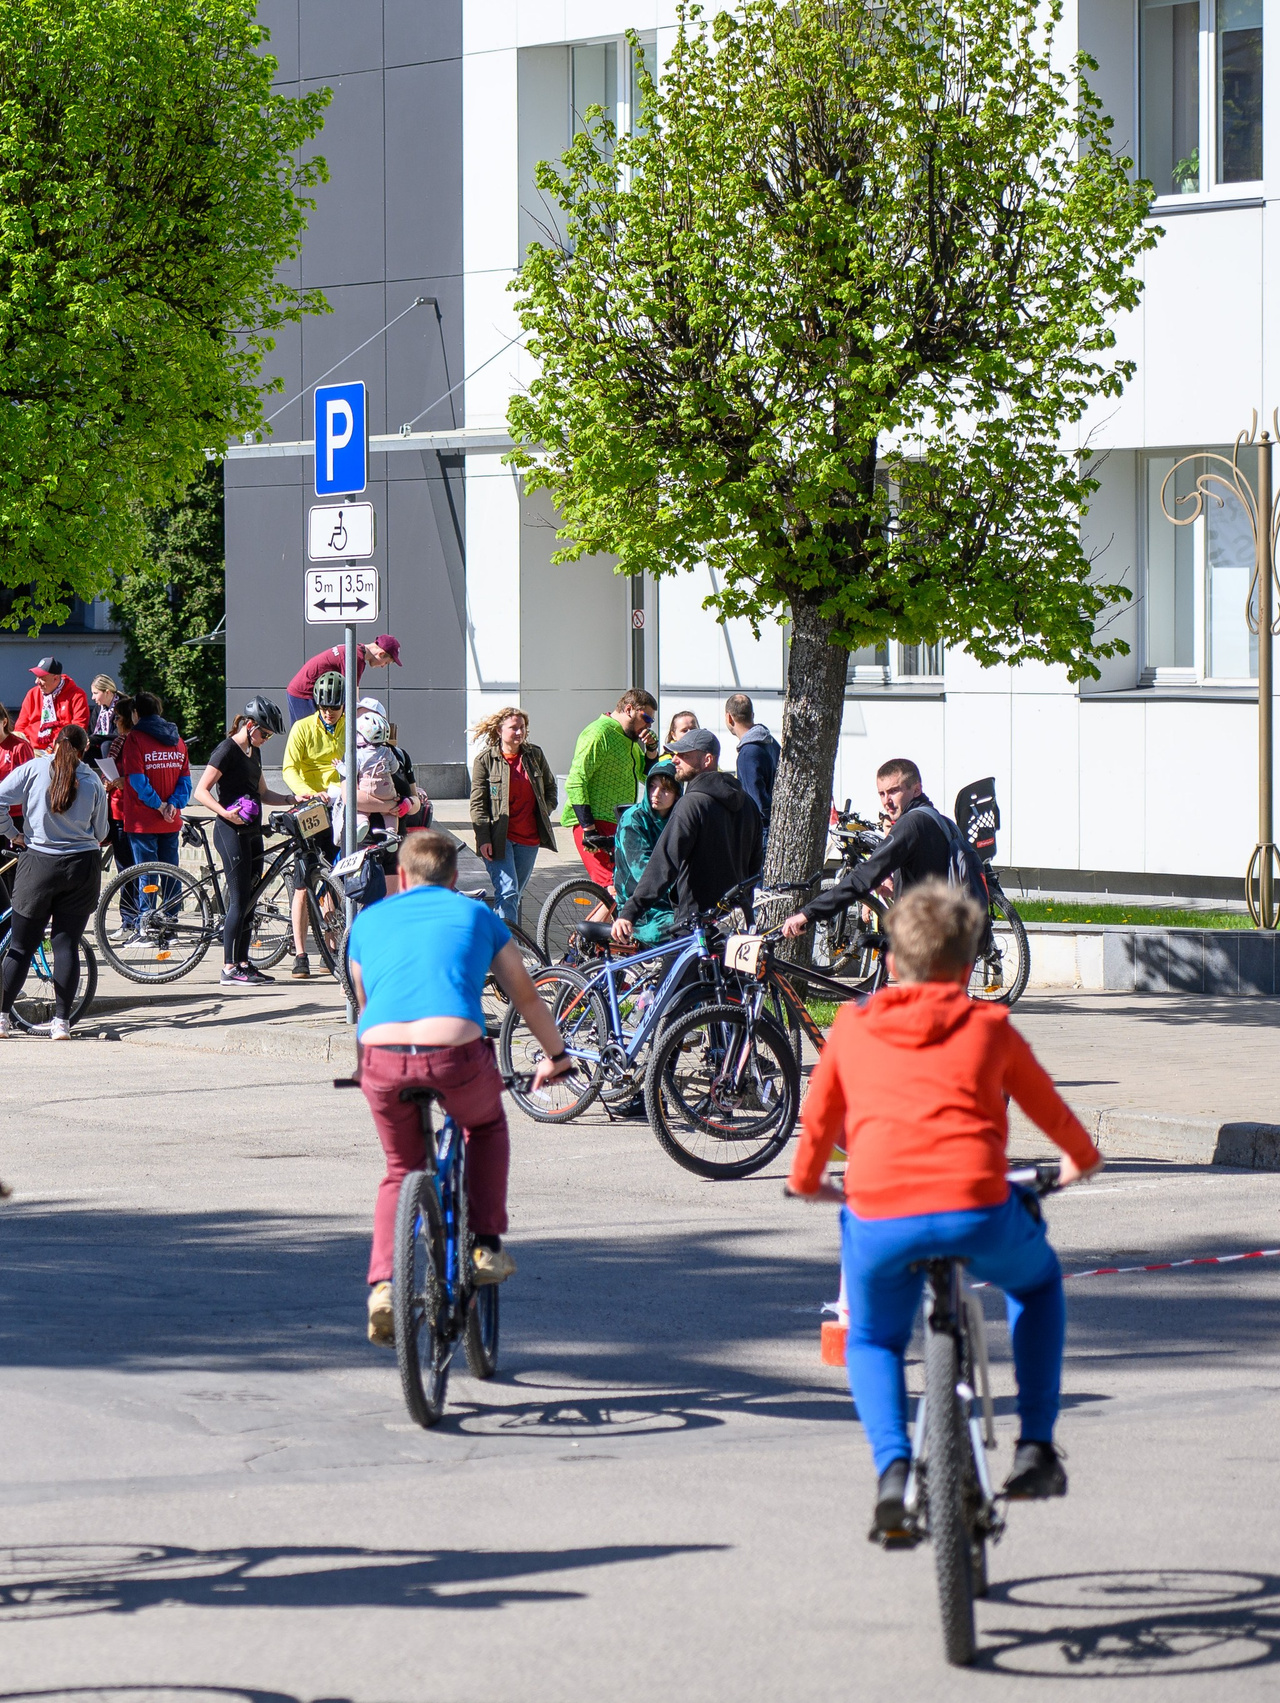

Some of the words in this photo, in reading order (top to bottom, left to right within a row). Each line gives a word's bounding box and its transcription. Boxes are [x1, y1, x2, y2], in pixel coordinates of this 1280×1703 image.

[326, 398, 354, 482] P
[314, 575, 334, 593] 5m
[345, 574, 374, 594] 3,5m
[301, 814, 321, 832] 135
